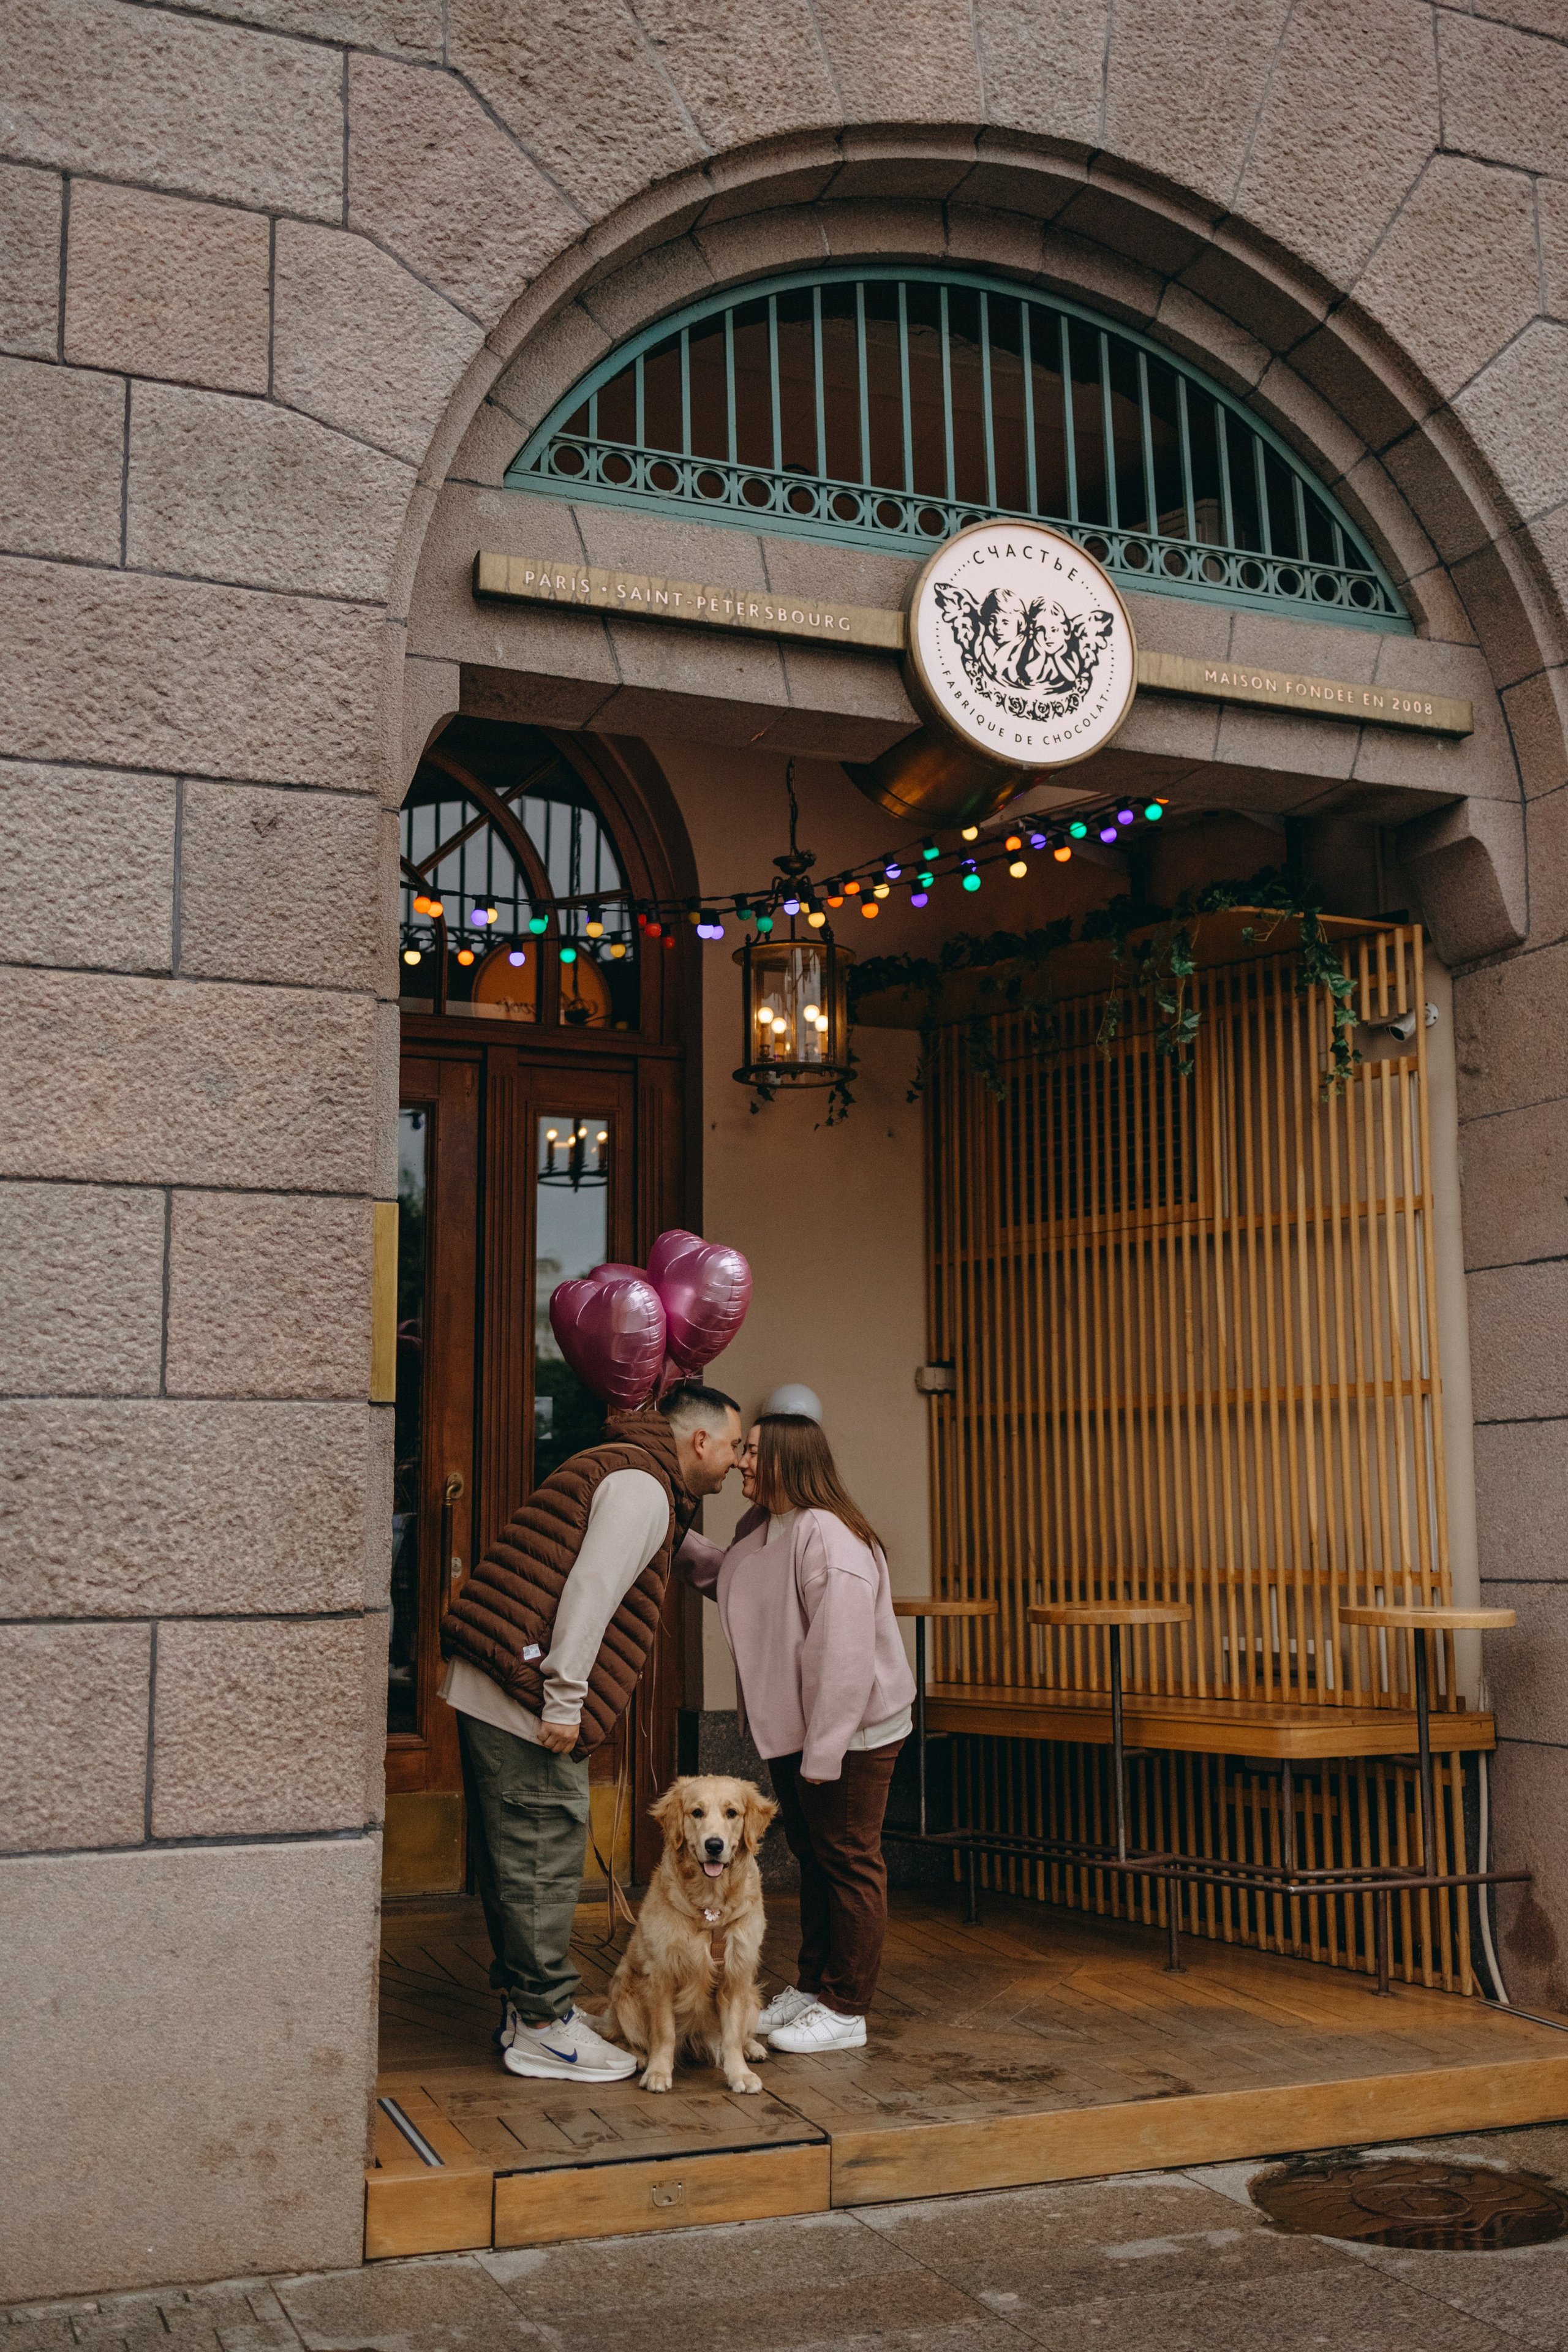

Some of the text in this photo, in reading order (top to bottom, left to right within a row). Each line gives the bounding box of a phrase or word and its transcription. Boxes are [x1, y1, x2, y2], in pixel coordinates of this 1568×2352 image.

[524, 570, 591, 594] PARIS
[973, 543, 1079, 581] СЧАСТЬЕ
[942, 669, 1109, 745] FABRIQUE DE CHOCOLAT
[1204, 669, 1278, 692] MAISON
[1363, 693, 1384, 708] EN
[1392, 698, 1433, 715] 2008
